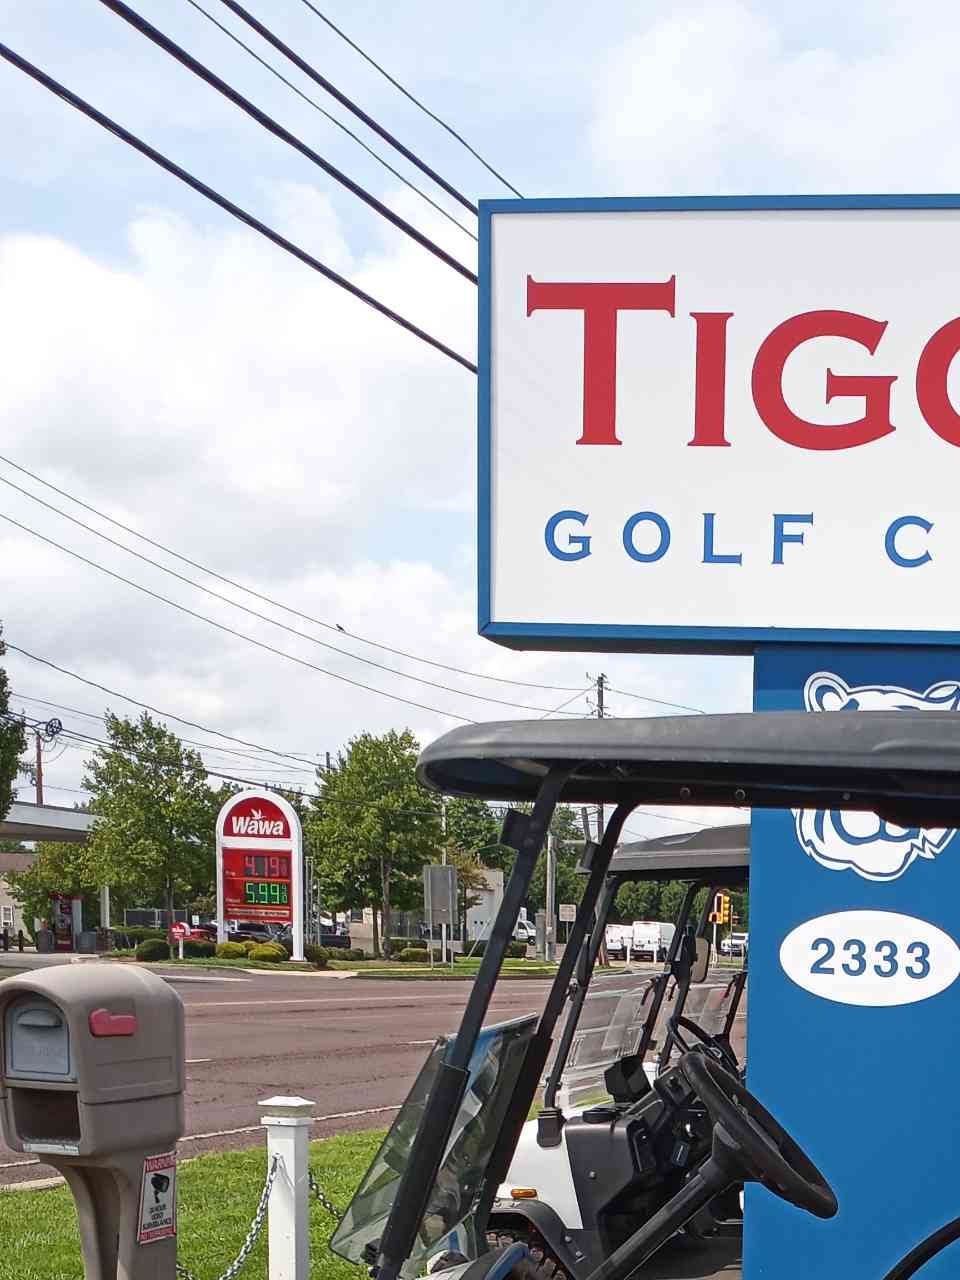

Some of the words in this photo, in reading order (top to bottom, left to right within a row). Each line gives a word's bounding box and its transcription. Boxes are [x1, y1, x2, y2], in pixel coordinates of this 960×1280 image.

[544, 509, 814, 566] GOLF
[231, 816, 284, 836] Wawa
[810, 937, 931, 979] 2333
